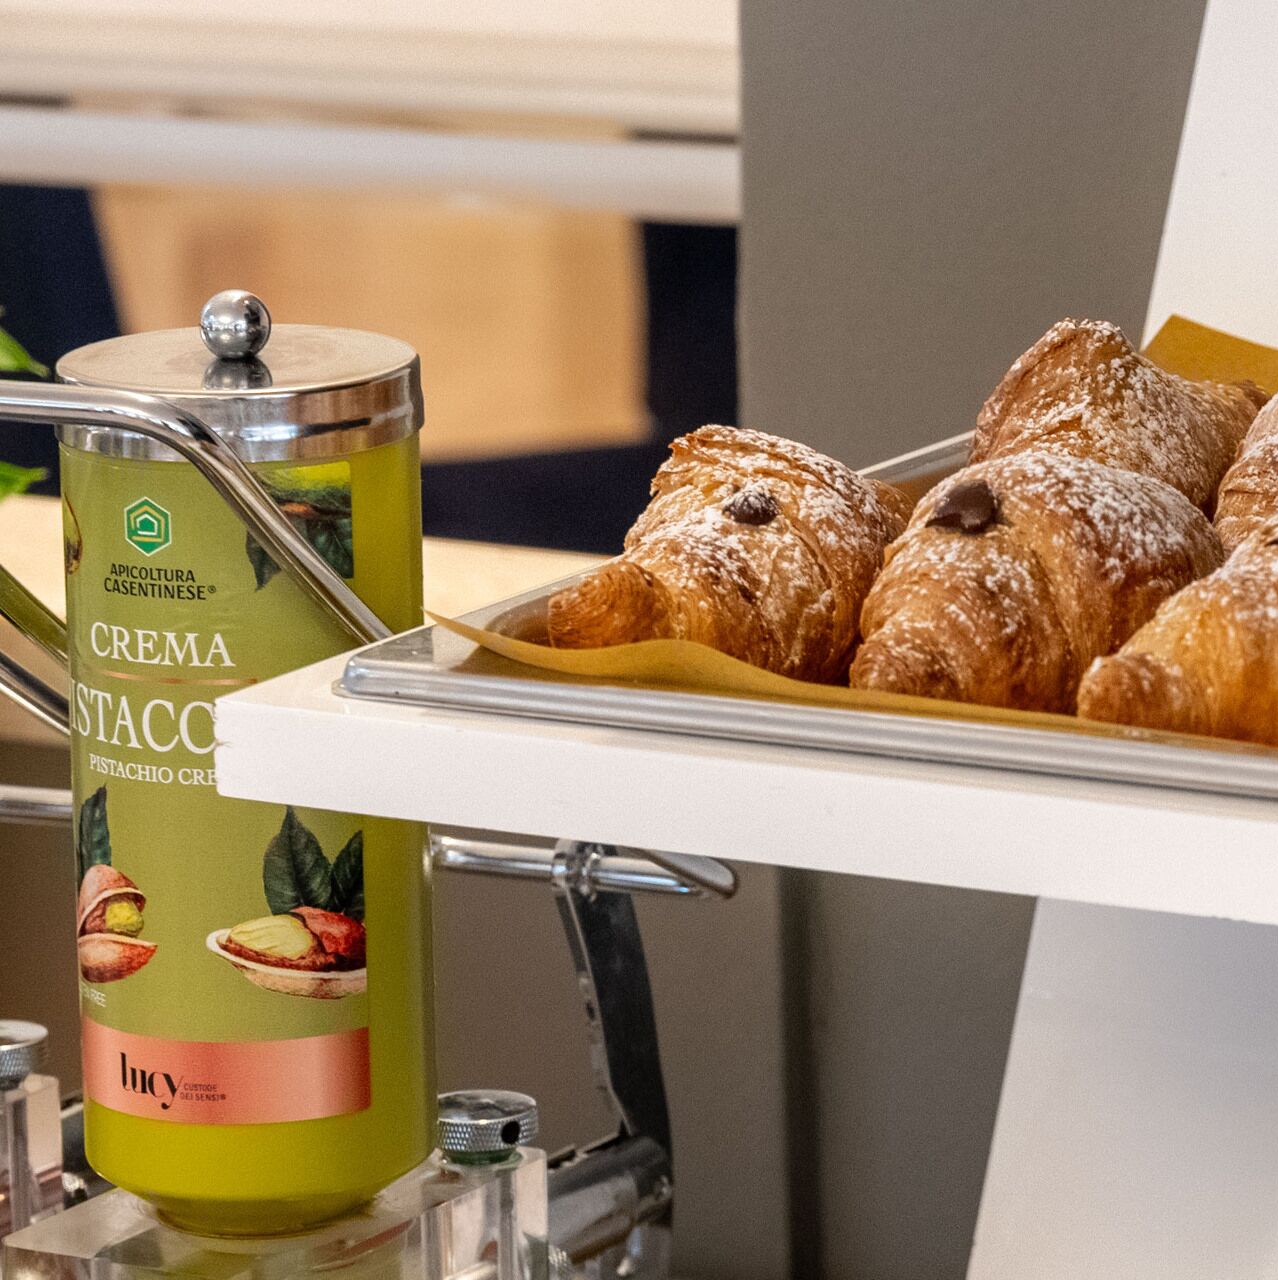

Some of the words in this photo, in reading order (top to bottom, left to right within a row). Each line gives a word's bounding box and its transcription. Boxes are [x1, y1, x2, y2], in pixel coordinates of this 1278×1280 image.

[110, 562, 196, 583] APICOLTURA
[91, 621, 236, 667] CREMA
[89, 753, 173, 784] PISTACHIO
[120, 1051, 184, 1110] lucy
